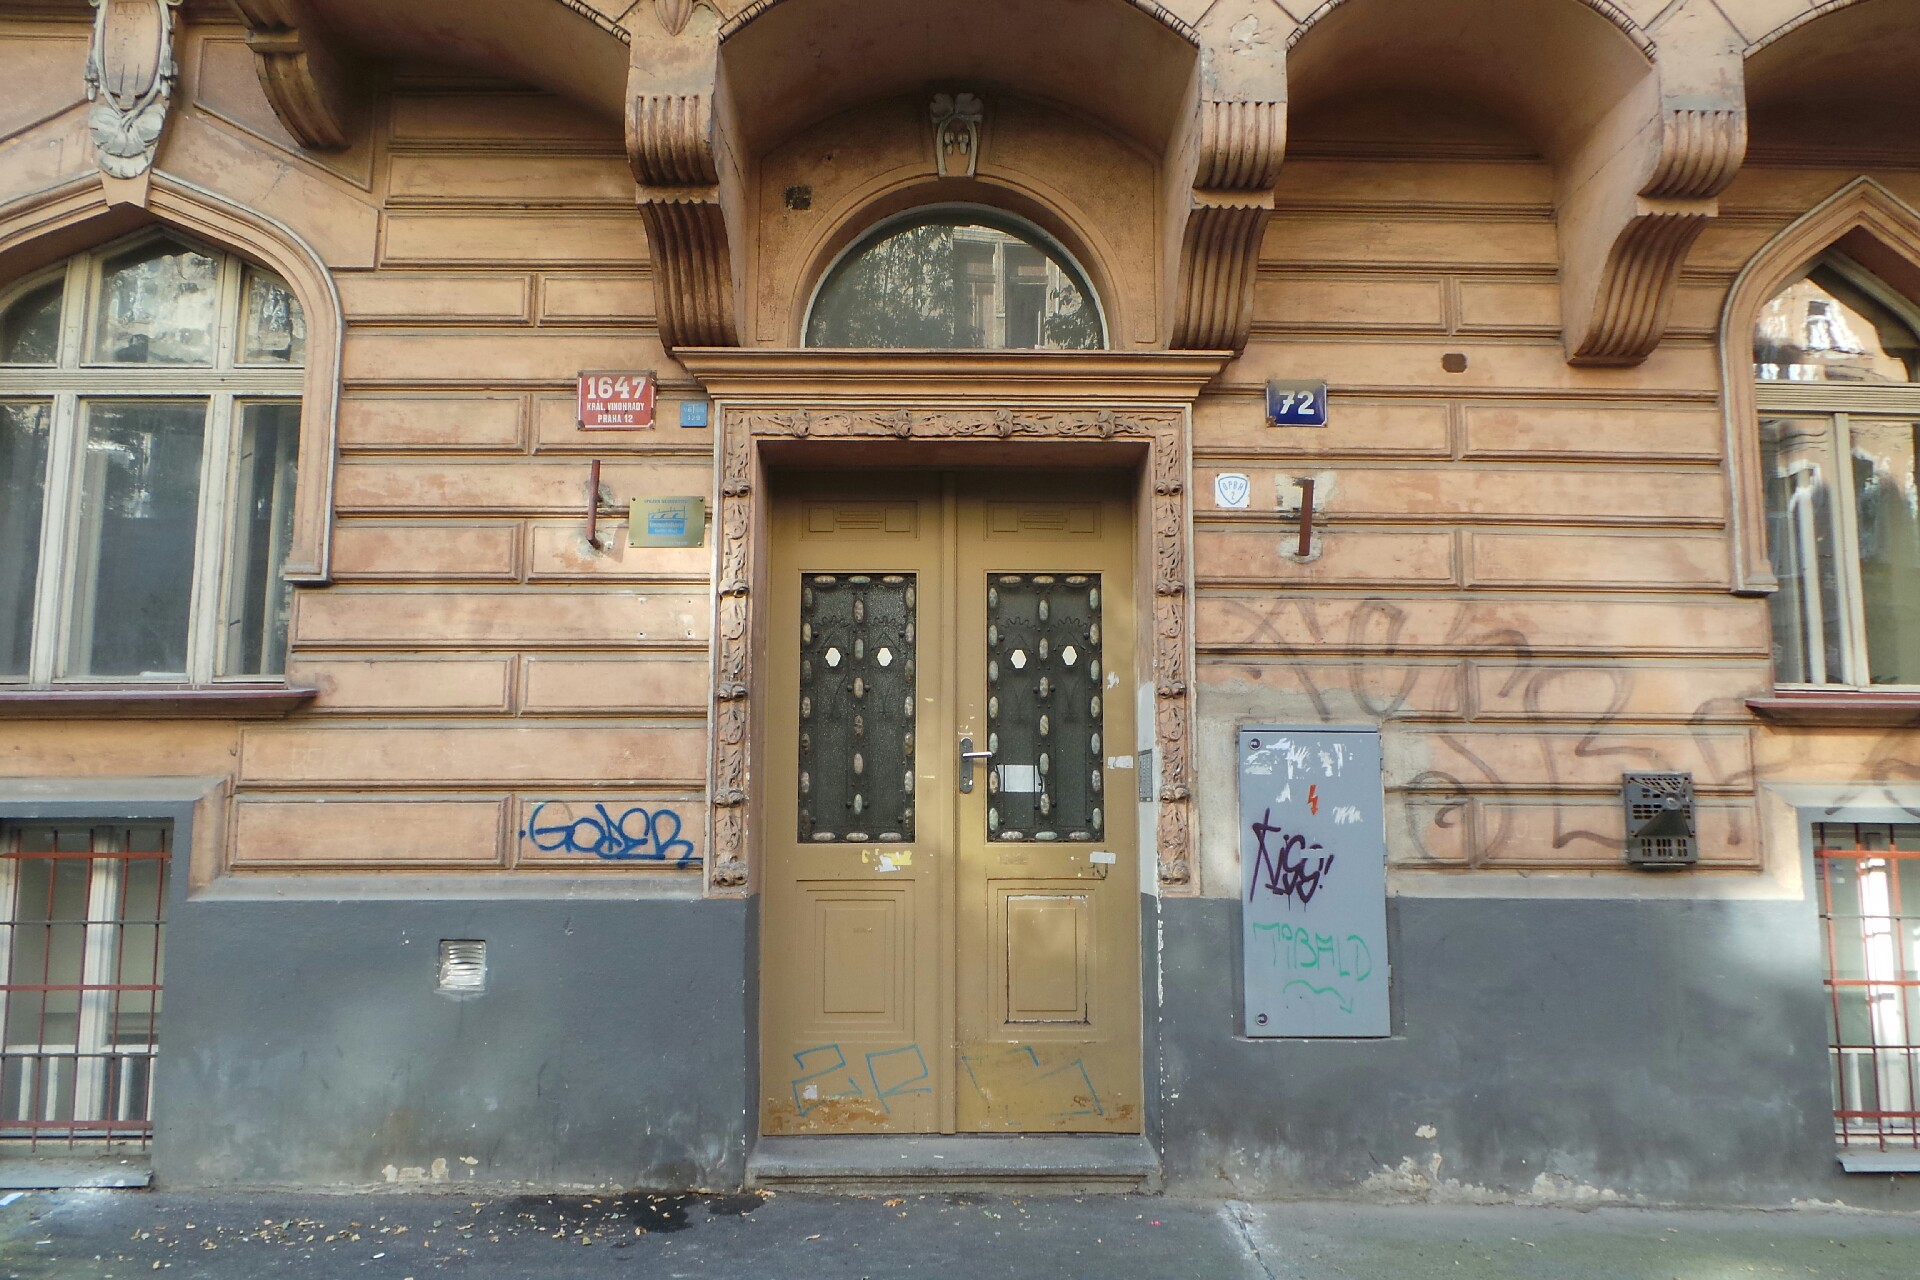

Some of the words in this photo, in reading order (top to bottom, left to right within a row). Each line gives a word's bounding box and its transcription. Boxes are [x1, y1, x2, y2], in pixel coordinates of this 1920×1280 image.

[587, 376, 647, 399] 1647
[586, 400, 606, 411] KRÁL.
[607, 402, 645, 411] VINOHRADY
[1279, 390, 1315, 415] 72
[597, 414, 622, 423] PRAHA
[624, 414, 634, 423] 12
